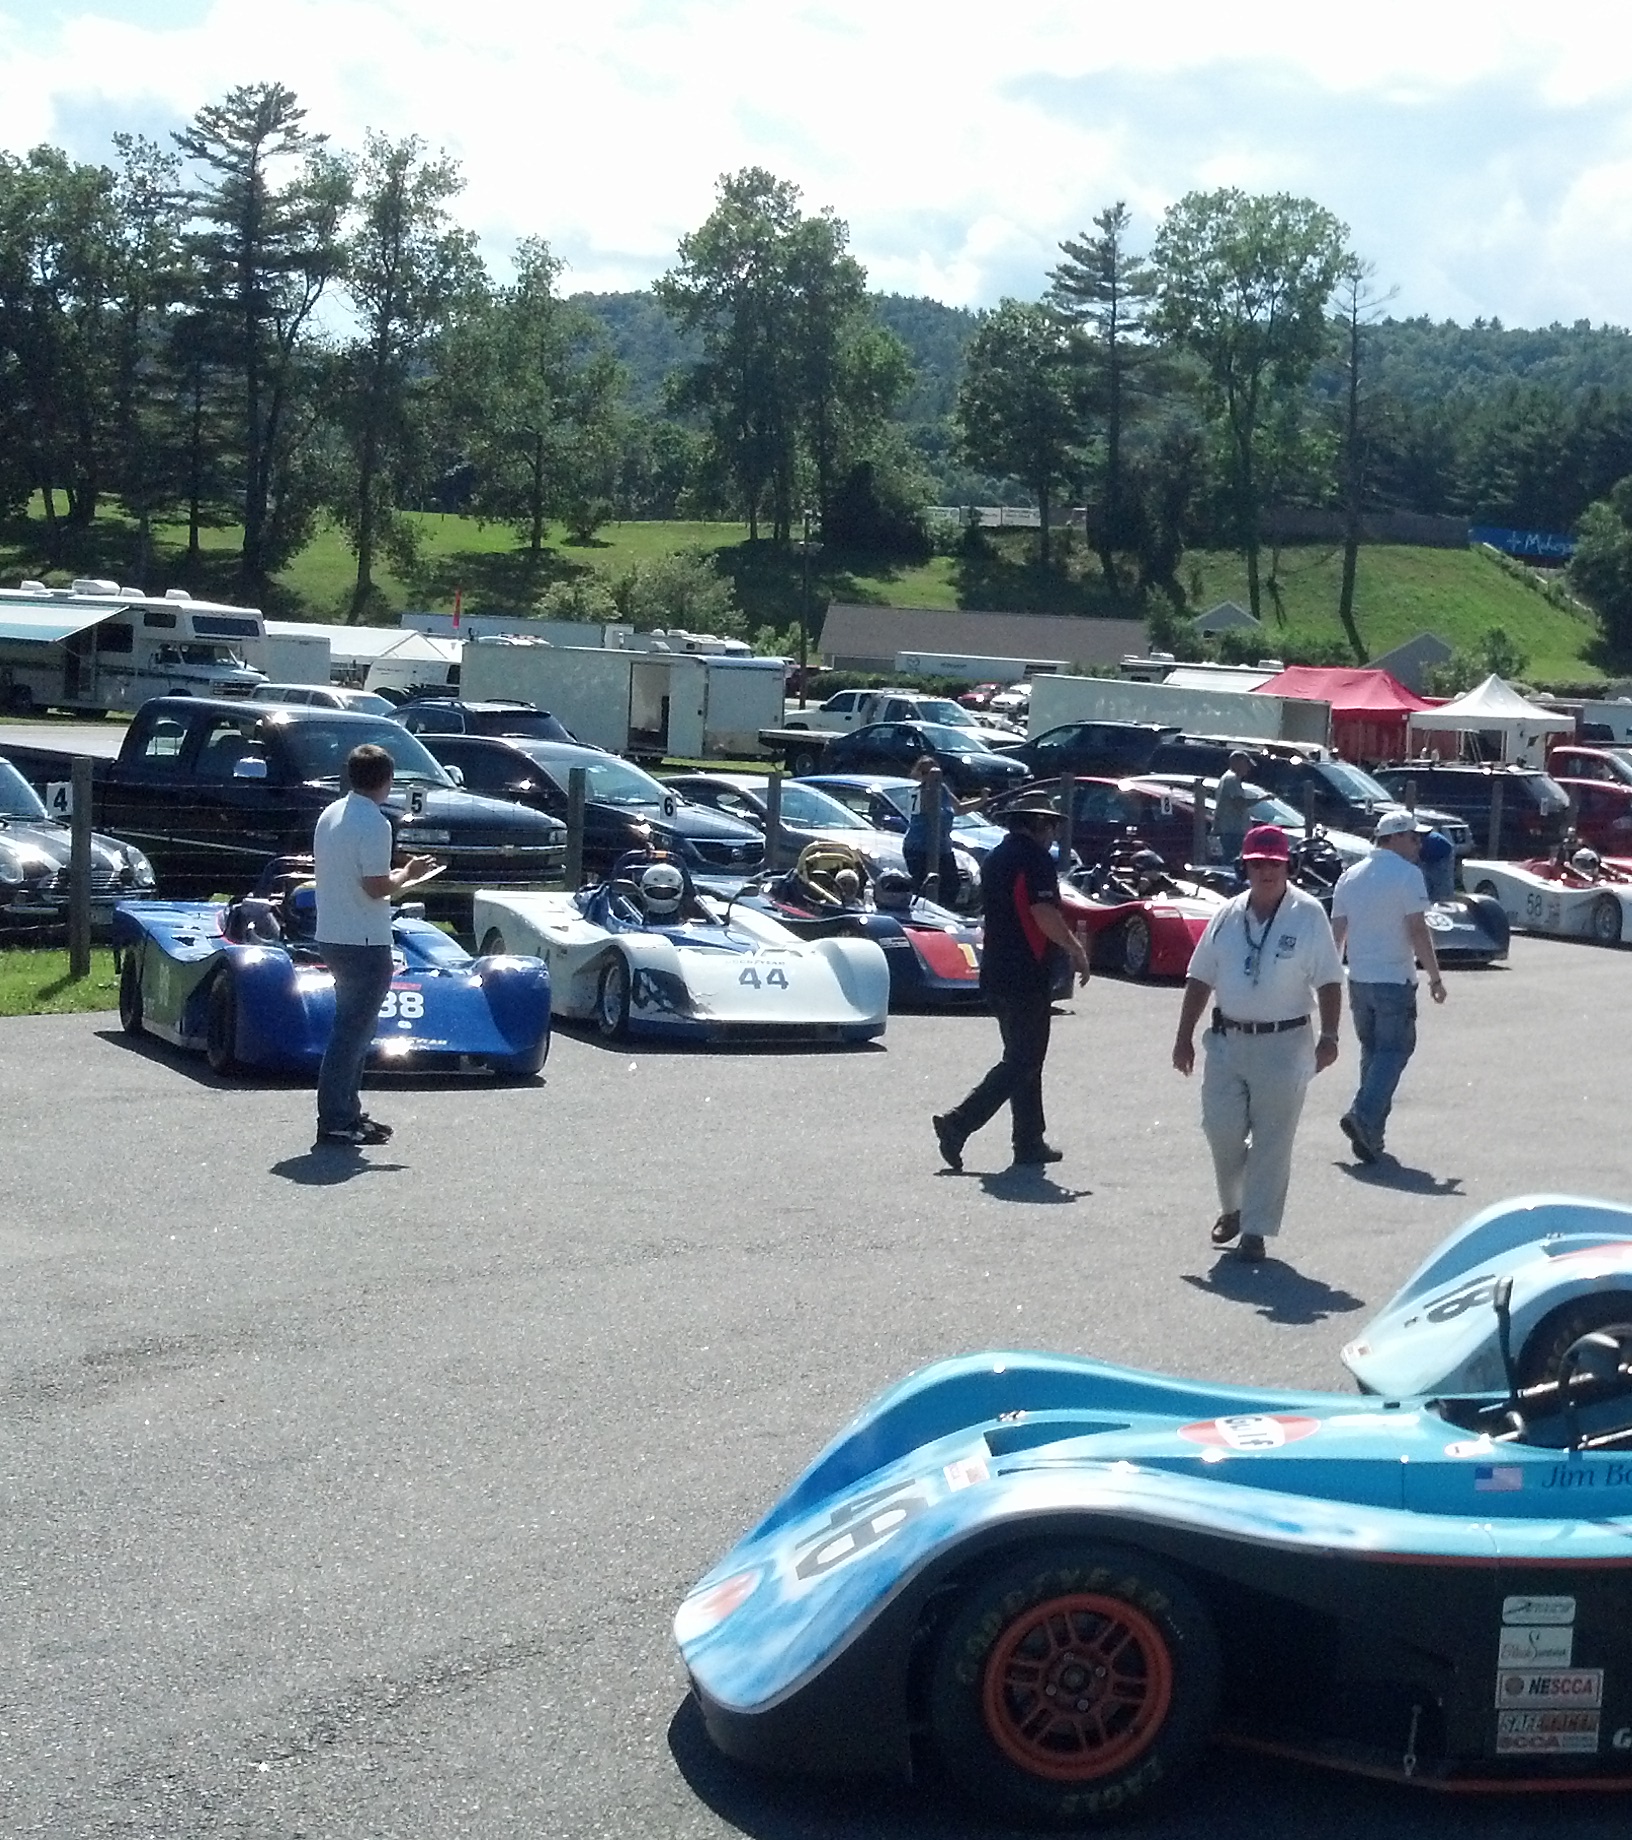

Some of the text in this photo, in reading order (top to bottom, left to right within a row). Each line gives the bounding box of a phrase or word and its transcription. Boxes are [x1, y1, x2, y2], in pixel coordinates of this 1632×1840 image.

[53, 787, 68, 812] 4
[410, 792, 423, 814] 5
[663, 796, 674, 817] 6
[911, 794, 918, 811] 7
[1527, 892, 1543, 917] 58
[738, 966, 790, 990] 44
[1422, 1274, 1496, 1324] 18
[1541, 1463, 1595, 1488] Jim
[794, 1478, 930, 1581] 48
[1528, 1675, 1594, 1696] NESCCA
